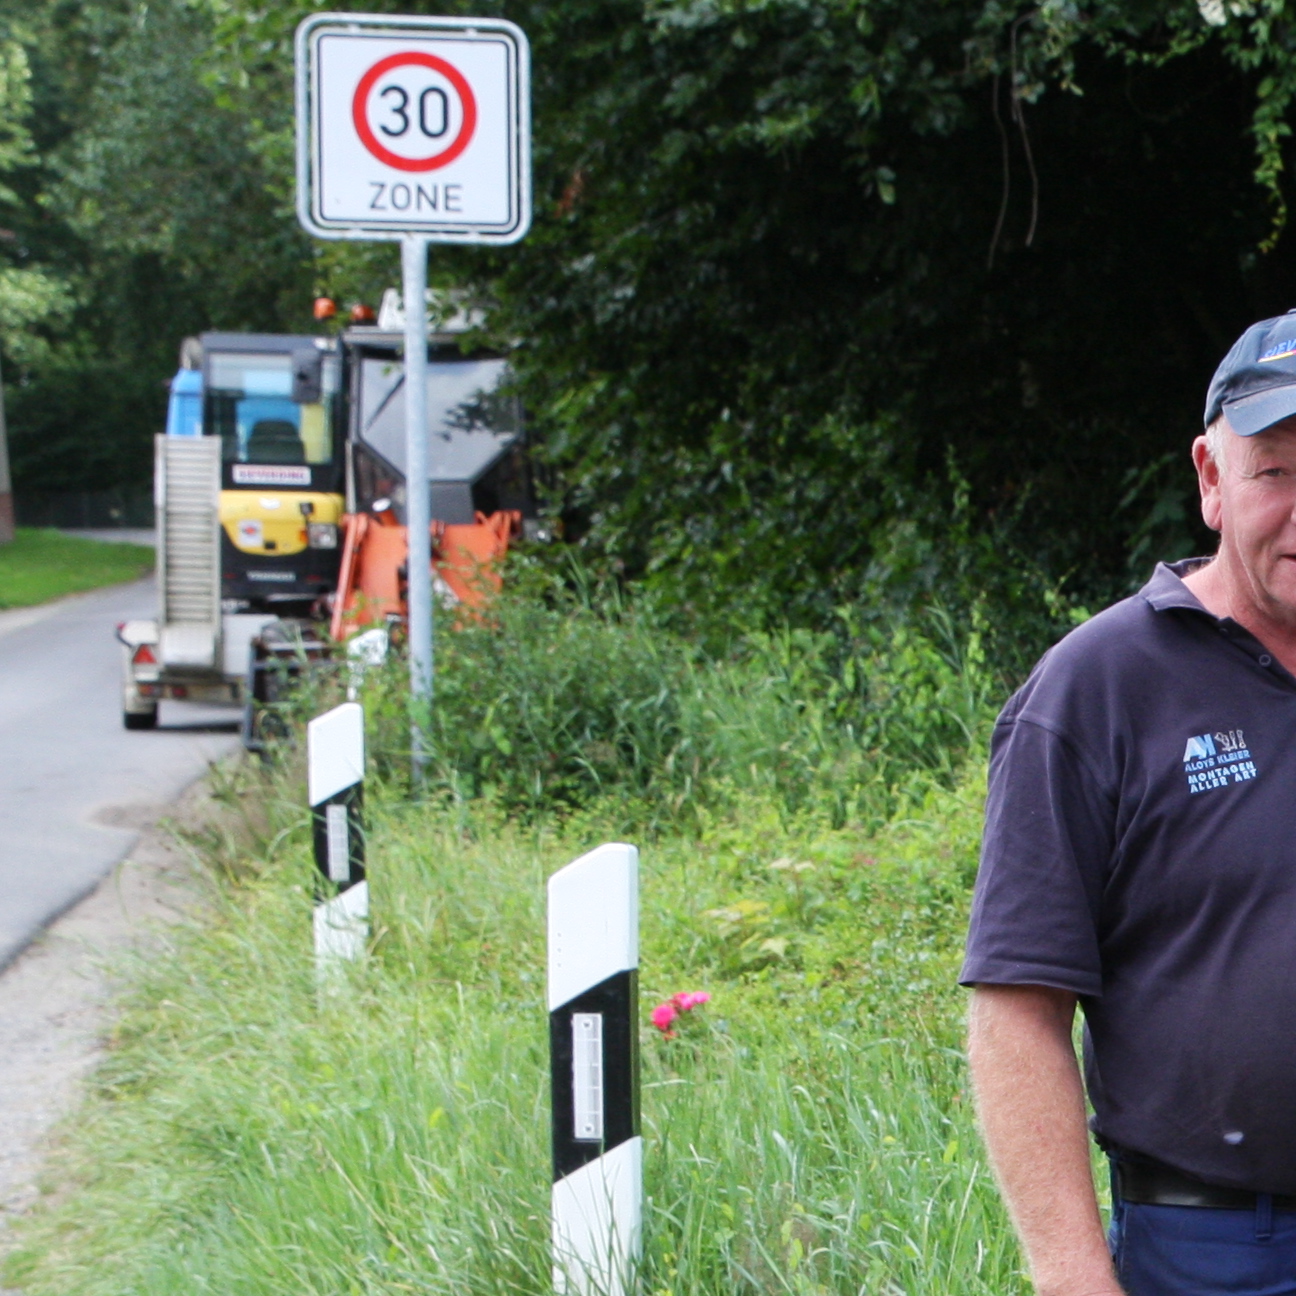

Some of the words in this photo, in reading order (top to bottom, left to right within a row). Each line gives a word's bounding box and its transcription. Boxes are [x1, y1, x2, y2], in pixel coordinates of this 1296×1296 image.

[379, 85, 450, 139] 30
[369, 182, 463, 213] ZONE
[1185, 758, 1215, 772] ALOYS
[1188, 761, 1255, 784] MONTAGEN
[1190, 776, 1228, 793] ALLER
[1234, 768, 1257, 782] ART
